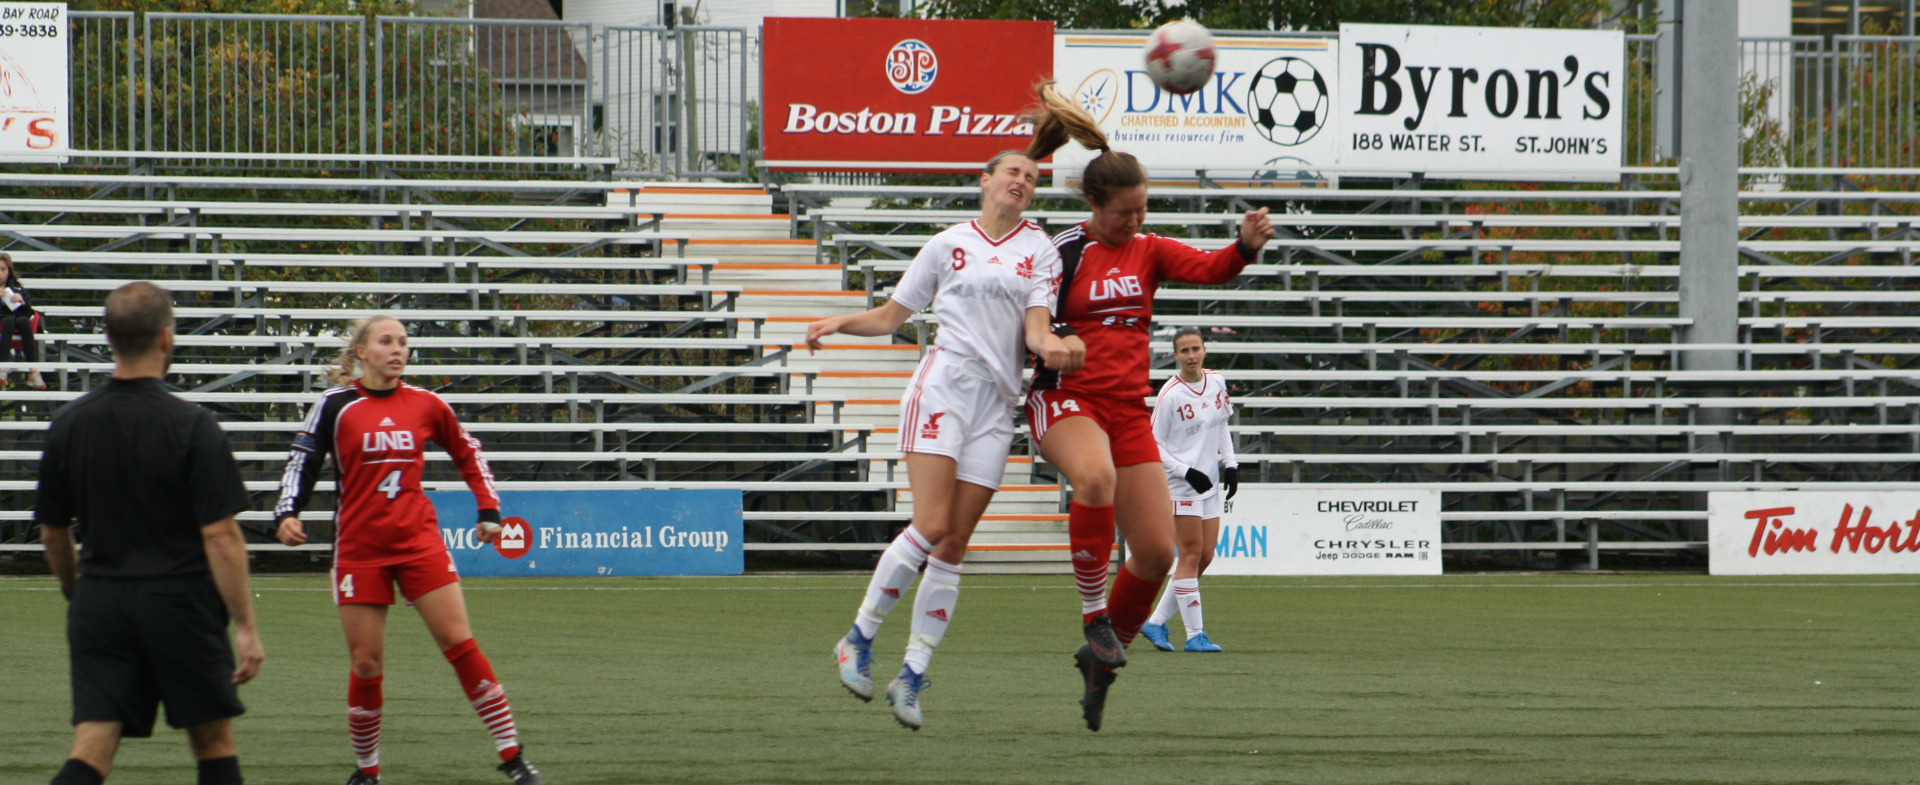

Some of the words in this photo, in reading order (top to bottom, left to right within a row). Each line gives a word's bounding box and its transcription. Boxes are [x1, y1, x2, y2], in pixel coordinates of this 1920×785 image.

[3, 7, 25, 19] BAY
[29, 7, 59, 20] ROAD
[1353, 42, 1611, 131] Byron's
[782, 103, 917, 135] Boston
[923, 106, 1035, 136] Pizza
[1121, 115, 1179, 127] CHARTERED
[1184, 116, 1246, 128] ACCOUNTANT
[1115, 129, 1160, 142] business
[1165, 132, 1215, 142] resources
[1218, 130, 1245, 144] firm
[1352, 133, 1383, 150] 188
[1389, 133, 1451, 151] WATER
[1459, 135, 1486, 152] ST.
[951, 247, 966, 271] 8
[1089, 275, 1143, 301] UNB
[1050, 399, 1081, 417] 14
[1176, 403, 1195, 421] 13
[362, 430, 416, 452] UNB
[377, 470, 402, 499] 4
[1223, 501, 1234, 514] BY
[1317, 500, 1419, 512] CHEVROLET
[1343, 514, 1394, 532] Cadillac
[1744, 506, 1818, 558] Tim
[539, 525, 652, 549] Financial
[658, 525, 729, 552] Group
[1313, 540, 1431, 549] CHRYSLER
[1315, 551, 1338, 561] Jeep
[339, 573, 355, 598] 4
